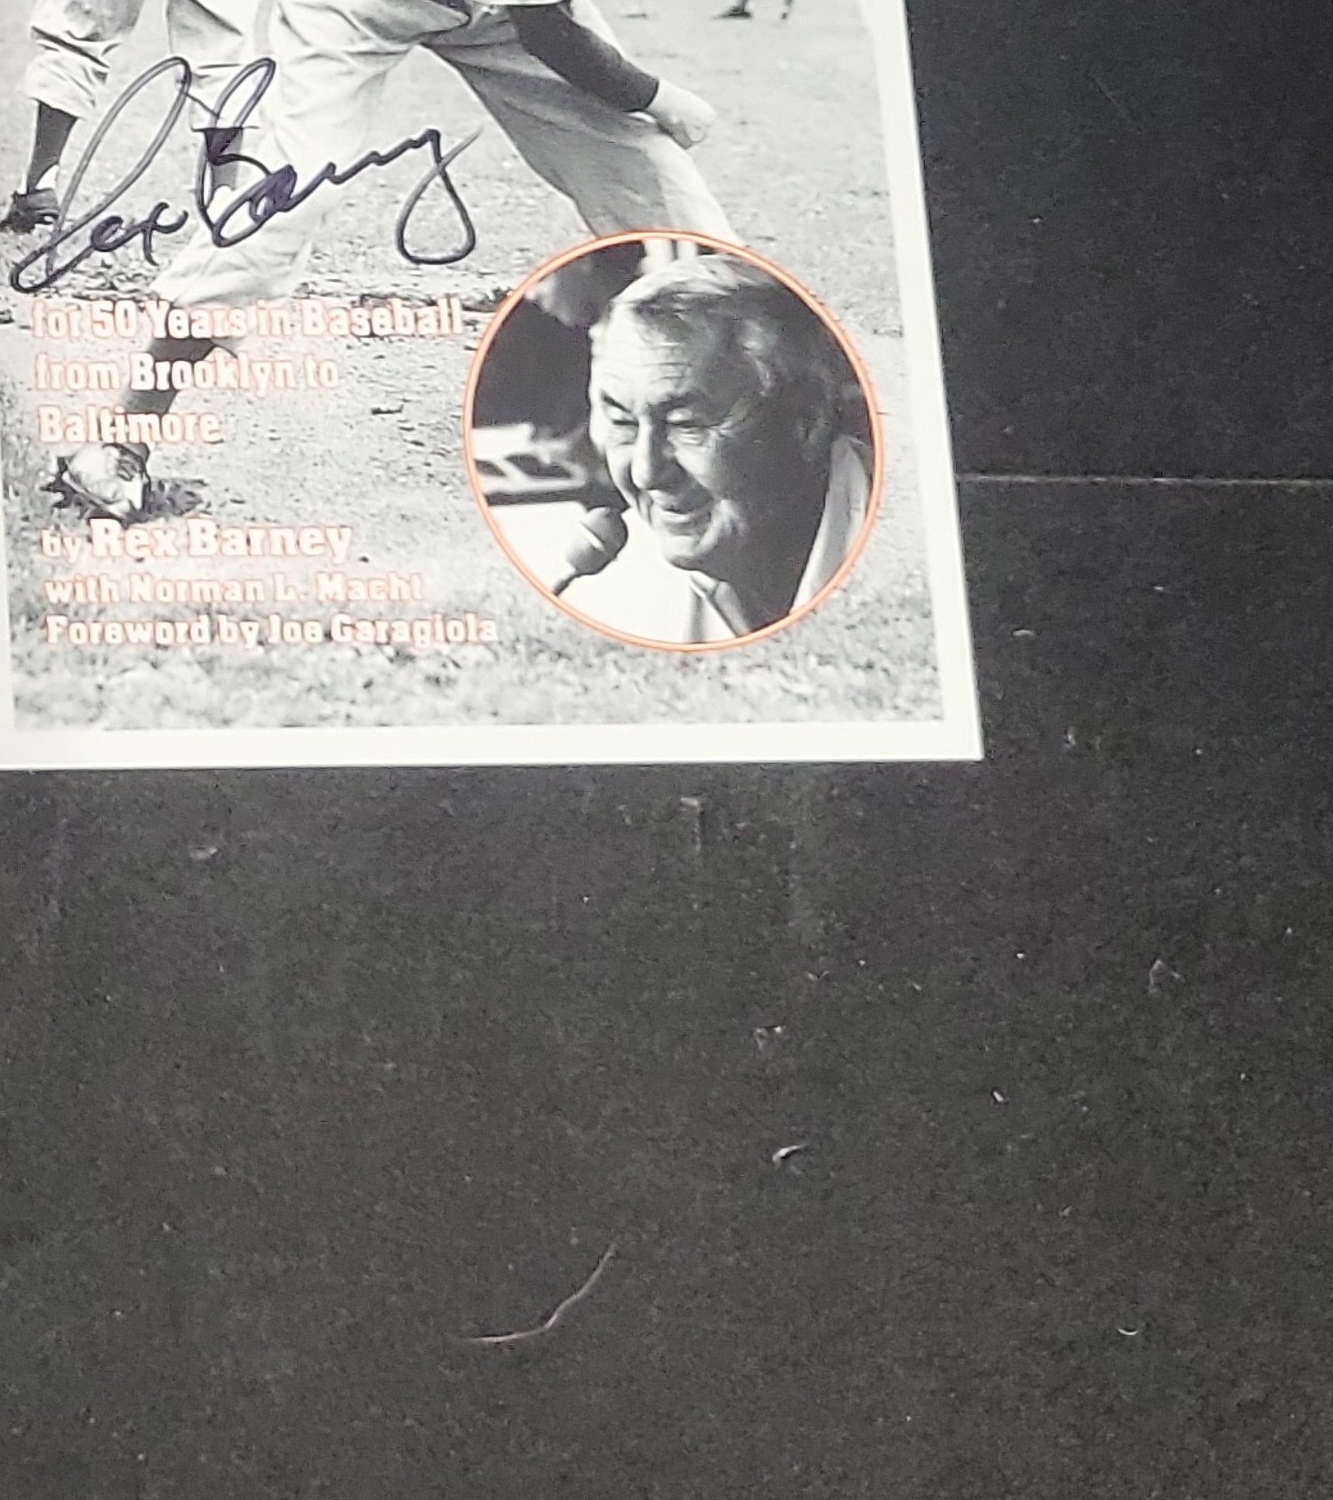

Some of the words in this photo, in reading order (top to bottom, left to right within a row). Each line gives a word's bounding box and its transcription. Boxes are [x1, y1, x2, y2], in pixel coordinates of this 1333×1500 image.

[33, 301, 81, 339] for
[90, 301, 135, 337] 50
[139, 300, 248, 339] Years
[256, 301, 292, 337] in
[300, 299, 463, 337] Baseball
[35, 353, 120, 392] from
[130, 353, 296, 396] Brooklyn
[305, 355, 339, 390] to
[38, 406, 222, 444] Baltimore
[40, 527, 82, 562] by
[89, 517, 178, 557] Rex
[188, 518, 351, 564] Barney
[44, 574, 120, 604] with
[129, 573, 265, 603] Norman
[275, 573, 307, 602] L.
[316, 571, 423, 602] Macht
[45, 615, 211, 646] Foreword
[218, 616, 259, 650] by
[268, 615, 323, 644] Joe
[331, 613, 498, 649] Garagiola
